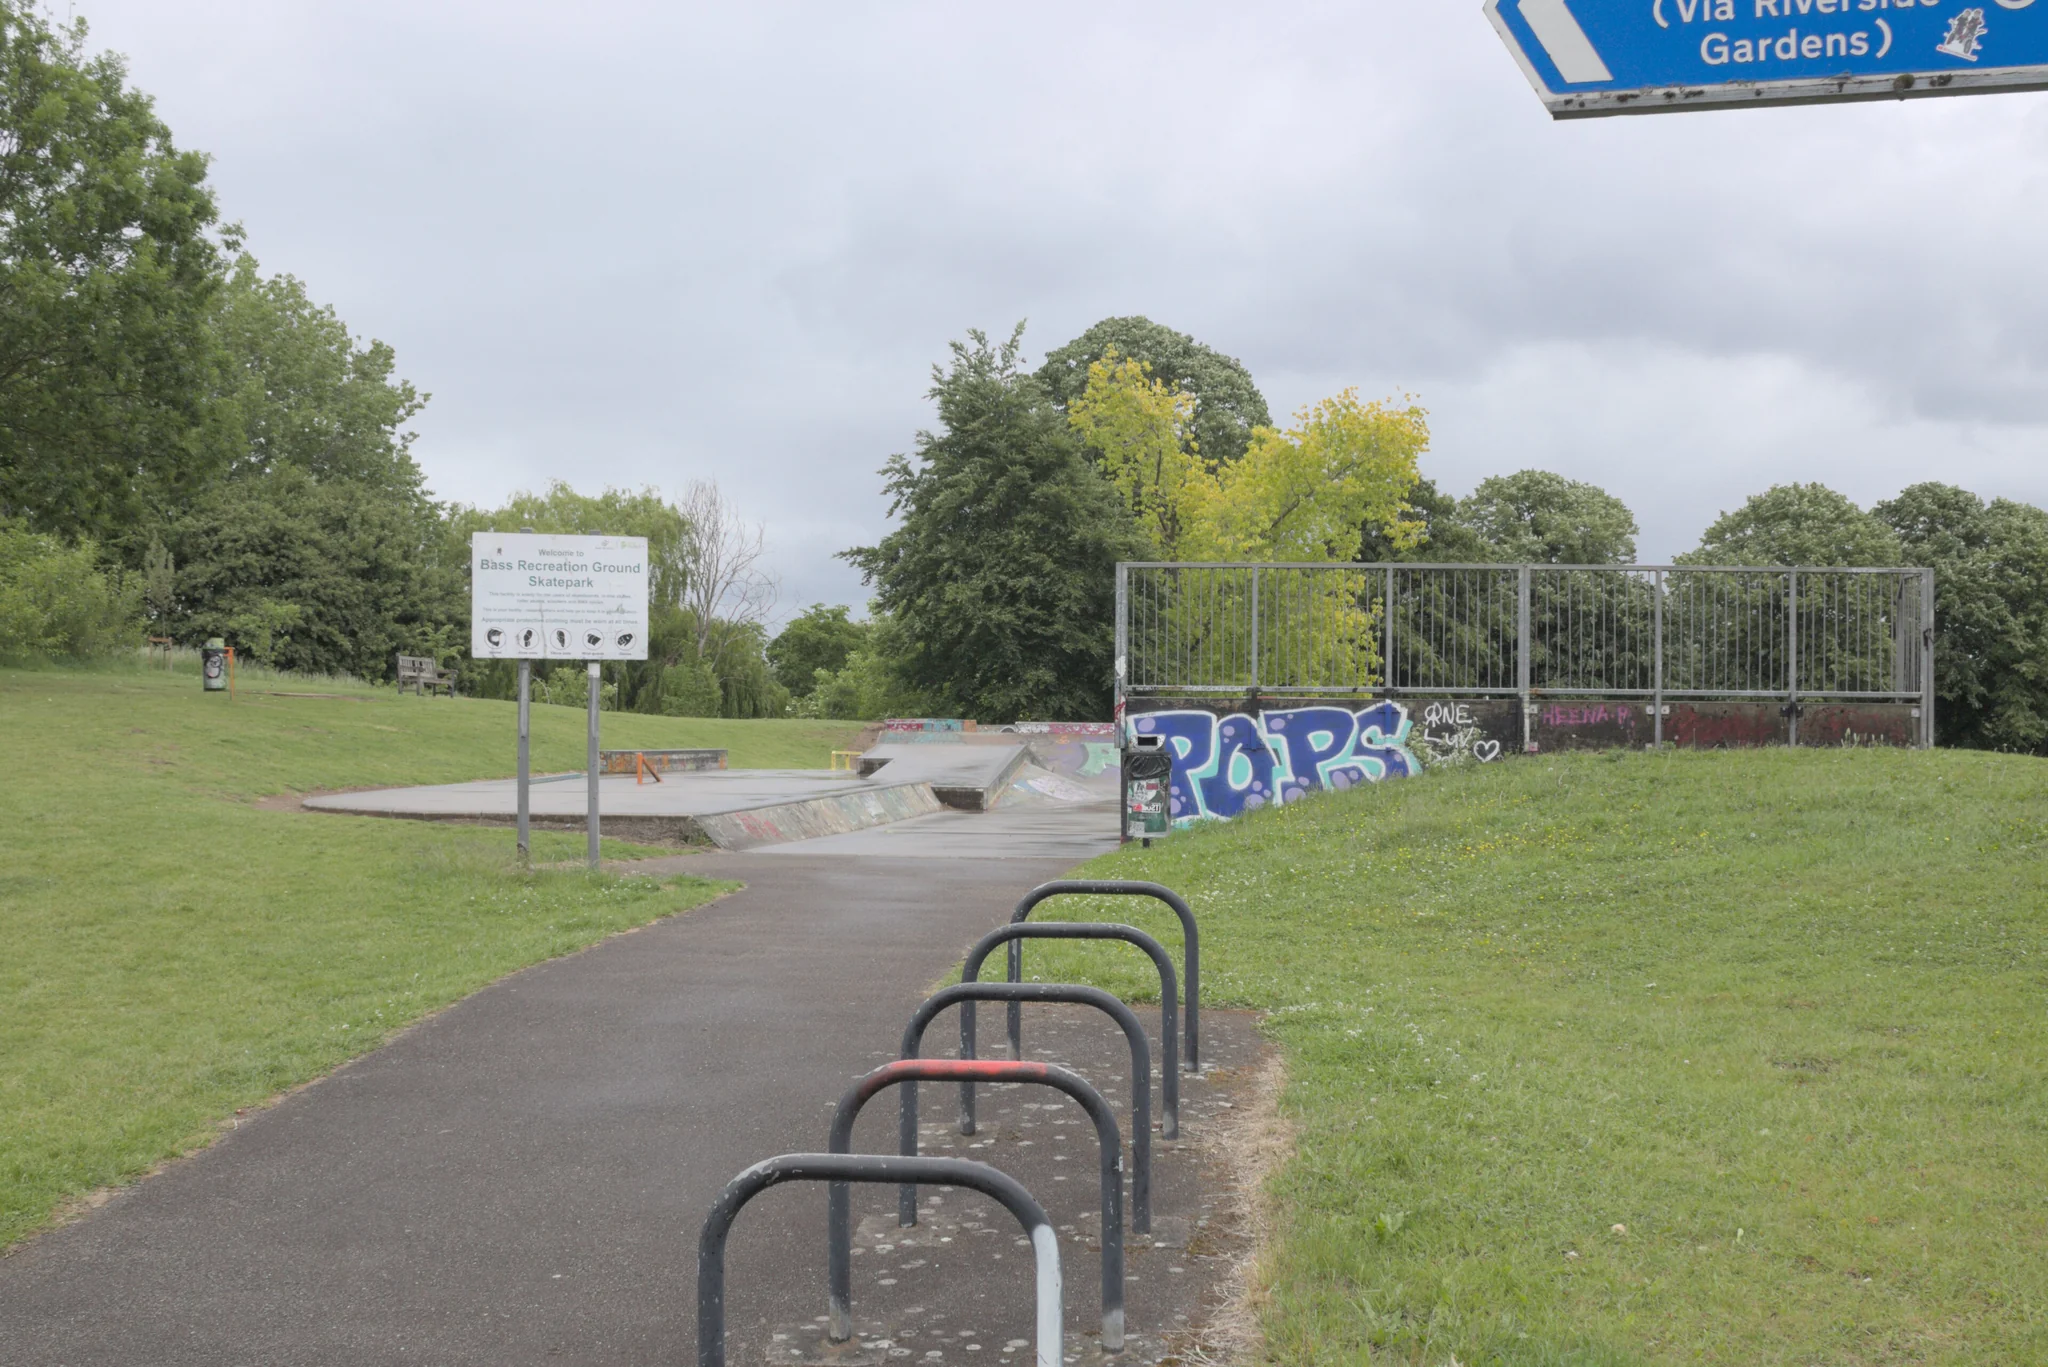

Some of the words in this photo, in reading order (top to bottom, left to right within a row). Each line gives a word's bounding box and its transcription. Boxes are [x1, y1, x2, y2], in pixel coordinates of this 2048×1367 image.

[1700, 17, 1893, 66] Gardens)
[538, 549, 574, 557] Welcome
[576, 549, 585, 557] to
[480, 559, 513, 571] Bass
[517, 559, 588, 572] Recreation
[592, 561, 641, 574] Ground
[528, 575, 594, 590] Skatepark
